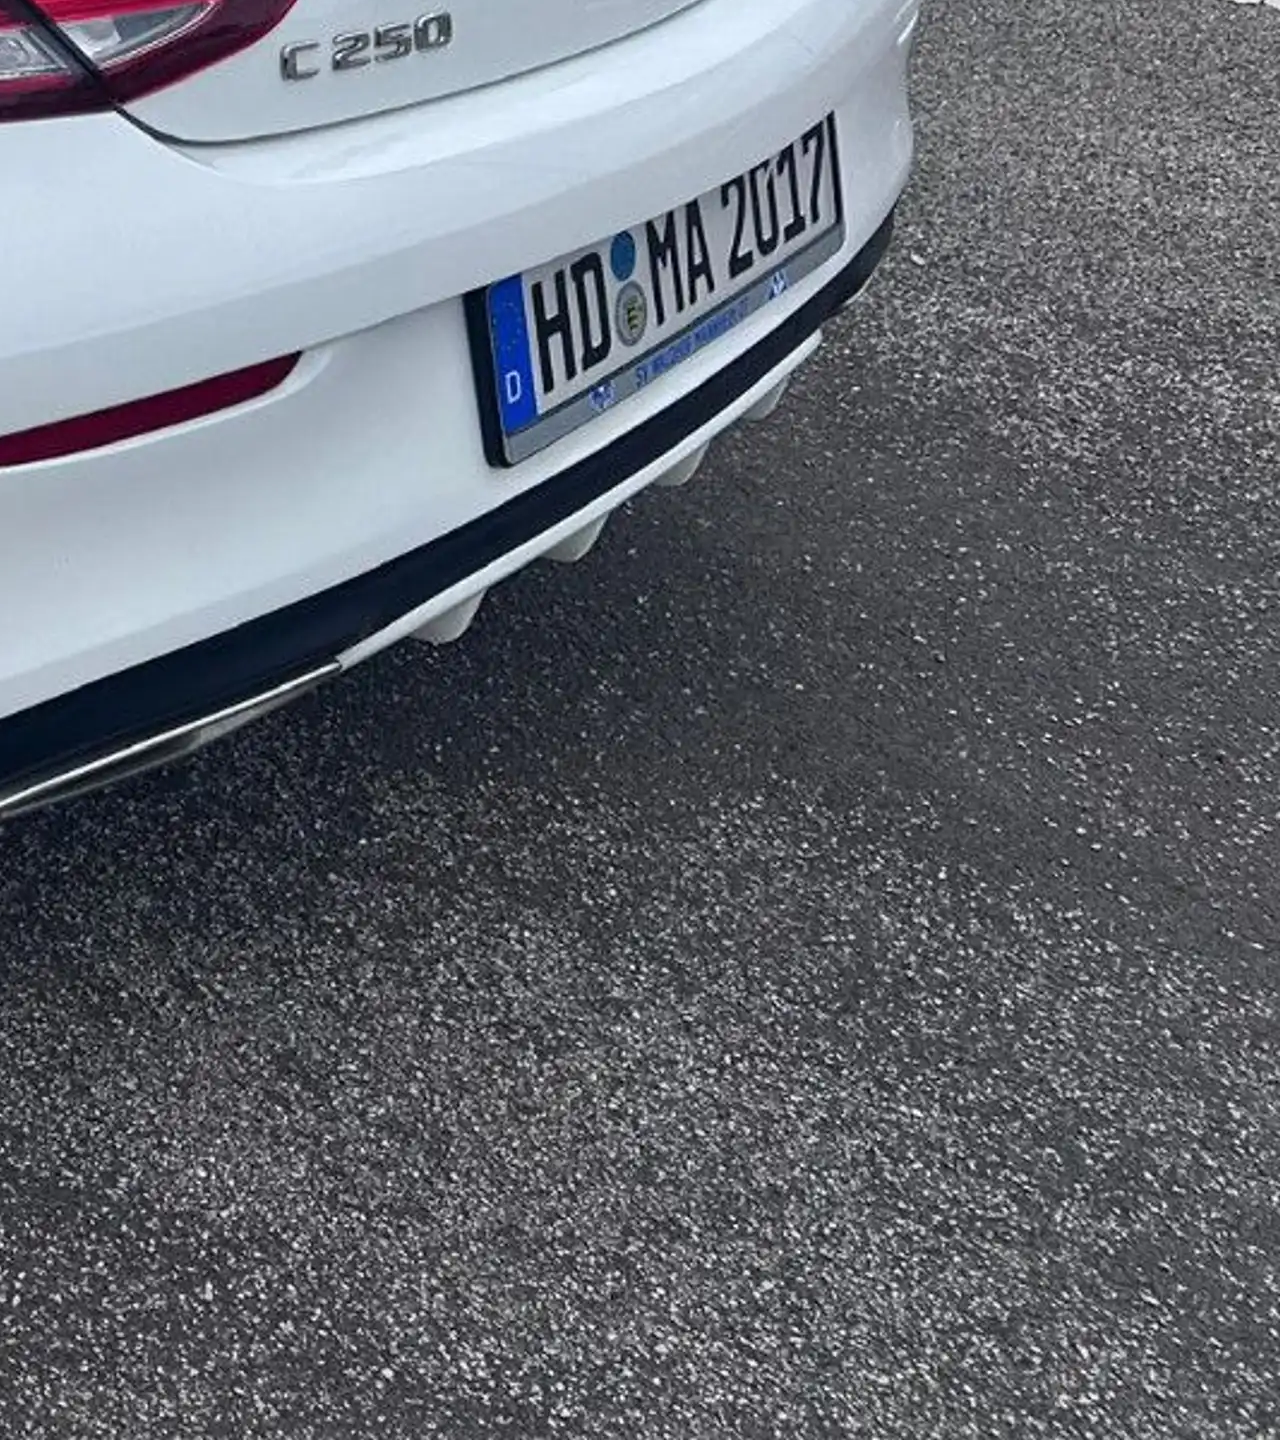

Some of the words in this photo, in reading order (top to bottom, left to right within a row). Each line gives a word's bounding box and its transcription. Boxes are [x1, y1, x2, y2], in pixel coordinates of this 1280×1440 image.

[279, 39, 321, 82] C
[331, 10, 453, 71] 250
[505, 370, 522, 404] D
[531, 251, 613, 395] HD
[645, 197, 715, 326] MA
[720, 120, 825, 279] 2017
